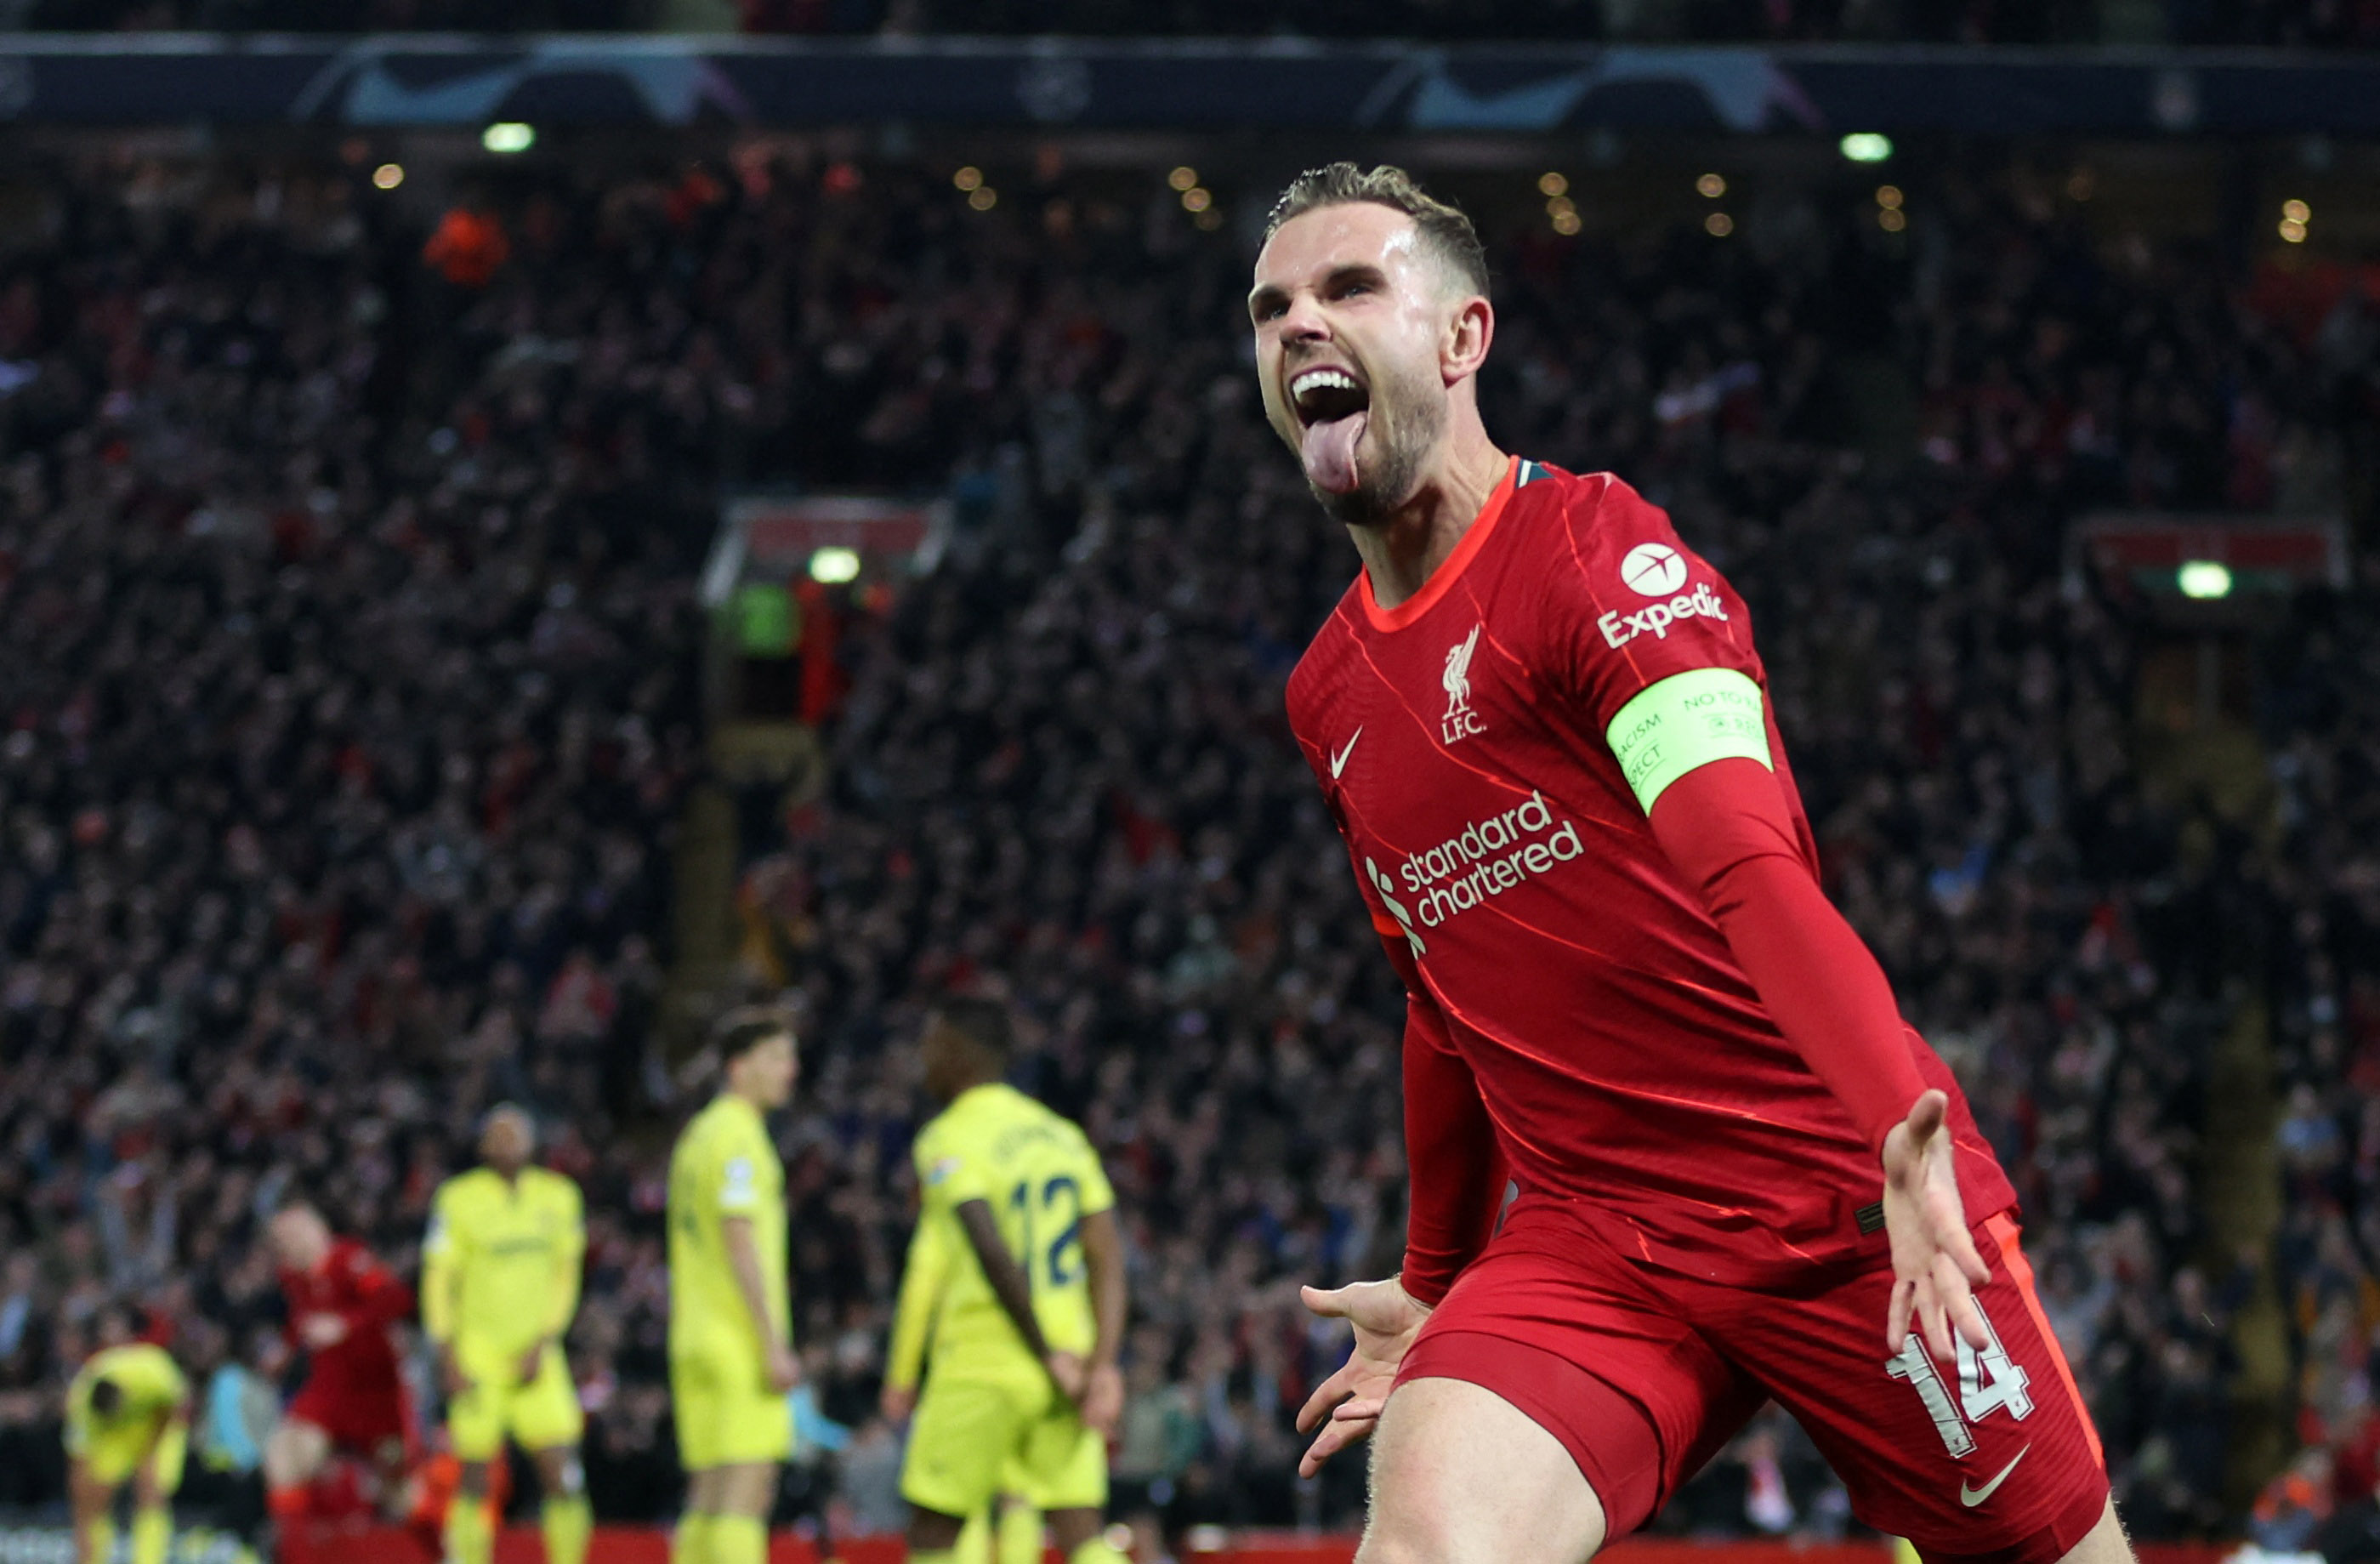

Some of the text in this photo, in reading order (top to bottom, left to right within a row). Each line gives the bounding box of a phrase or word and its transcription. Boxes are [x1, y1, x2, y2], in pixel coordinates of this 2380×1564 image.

[1684, 693, 1714, 711] NO
[1400, 788, 1552, 893] standard
[1417, 820, 1584, 927] chartered
[1010, 1177, 1085, 1287] 12
[1884, 1293, 2036, 1459] 14
